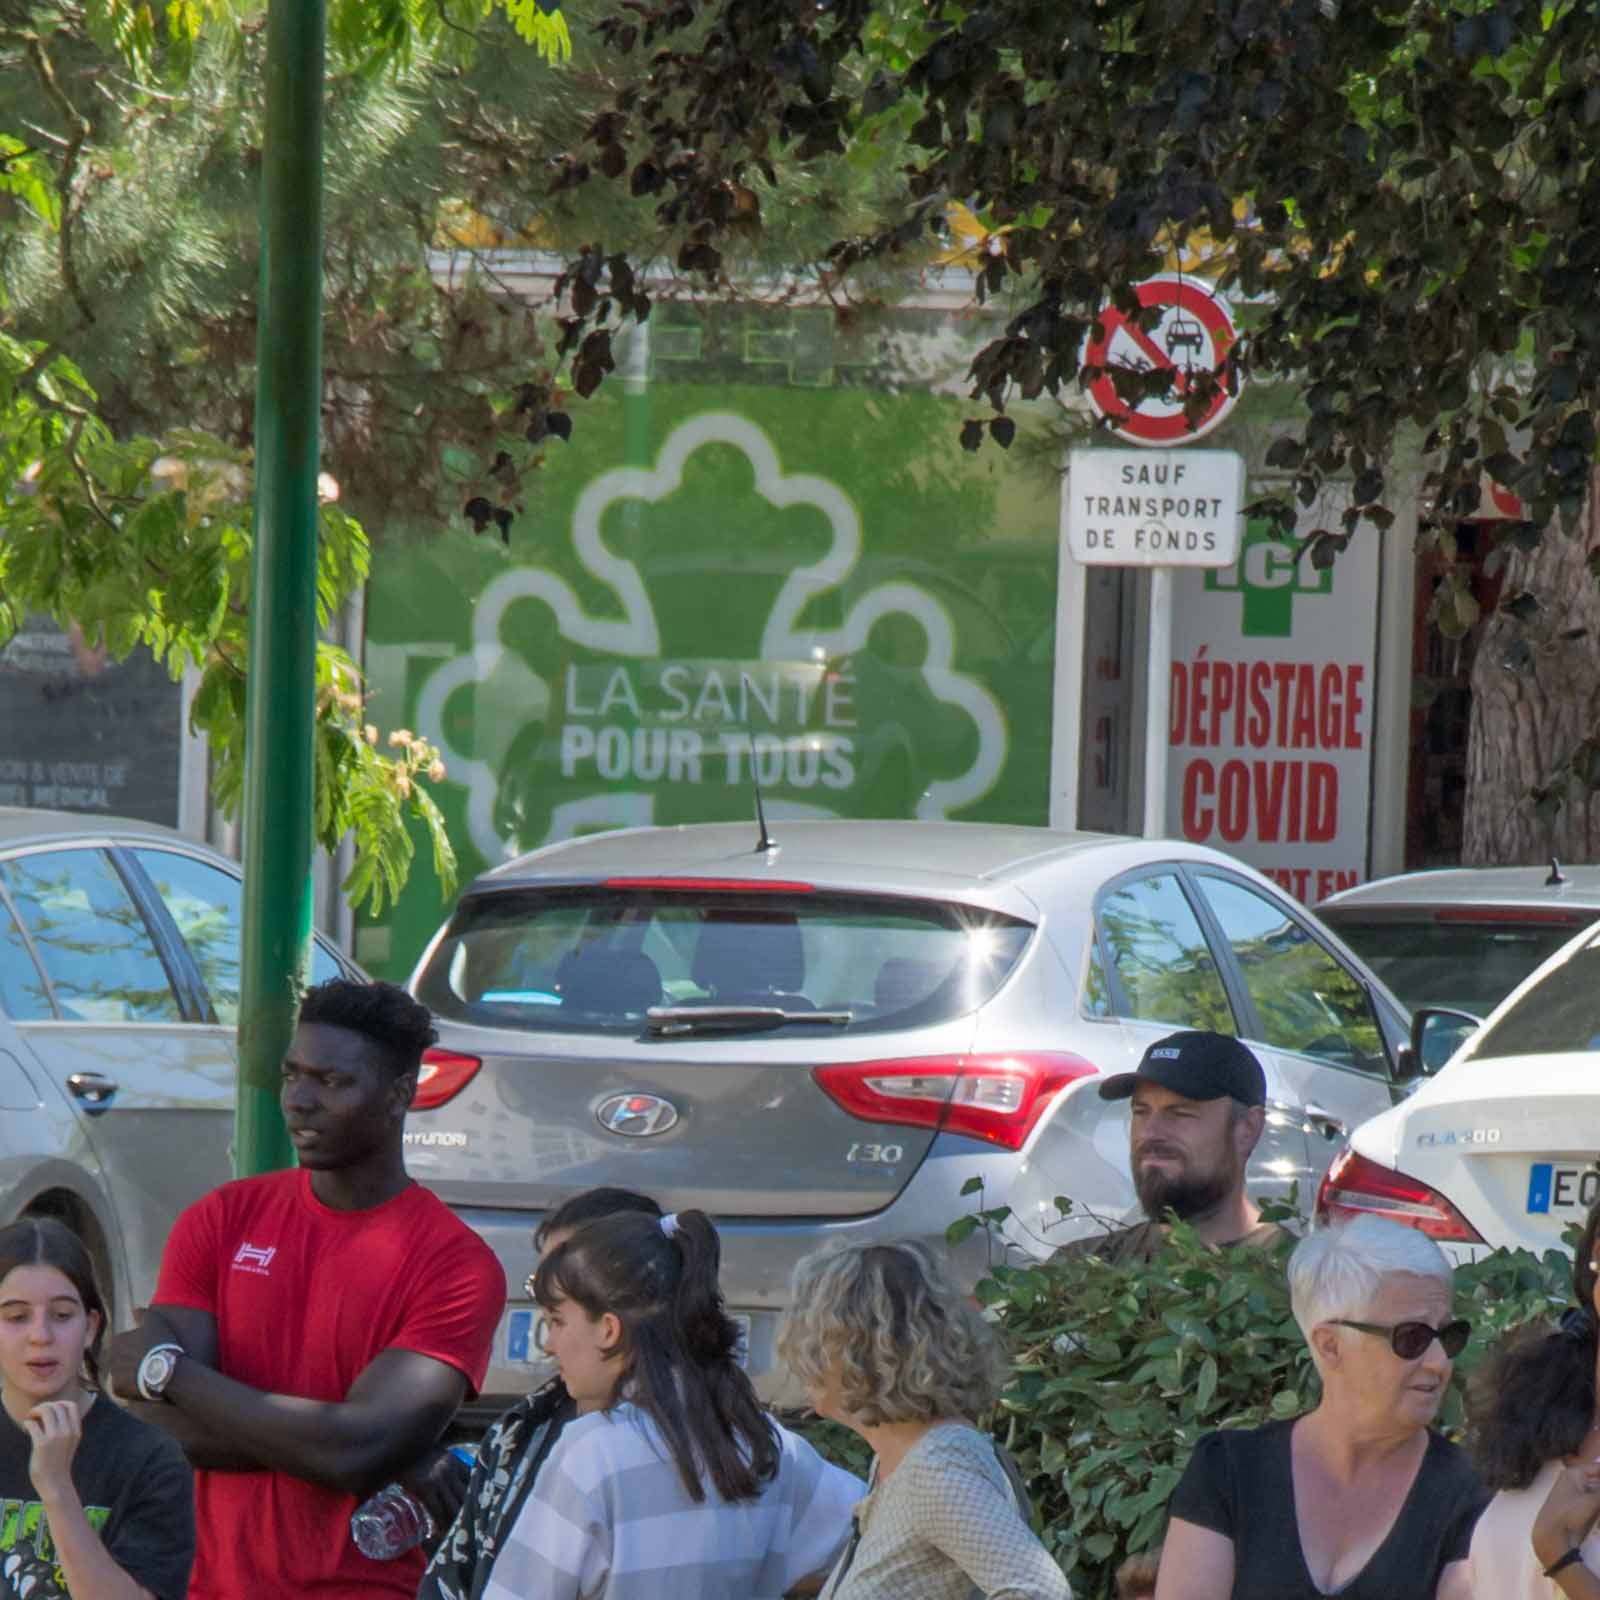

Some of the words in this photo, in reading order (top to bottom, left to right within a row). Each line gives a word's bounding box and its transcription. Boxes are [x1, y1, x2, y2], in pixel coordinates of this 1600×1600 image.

[1084, 496, 1223, 518] TRANSPORT
[1121, 464, 1187, 485] SAUF
[1085, 529, 1116, 550] DE
[1135, 529, 1217, 551] FONDS
[565, 663, 641, 717] LA
[657, 661, 858, 727] SANTÉ
[1169, 645, 1364, 750] DÉPISTAGE
[561, 723, 702, 783] POUR
[718, 732, 856, 789] TOUS
[1181, 758, 1339, 843] COVID
